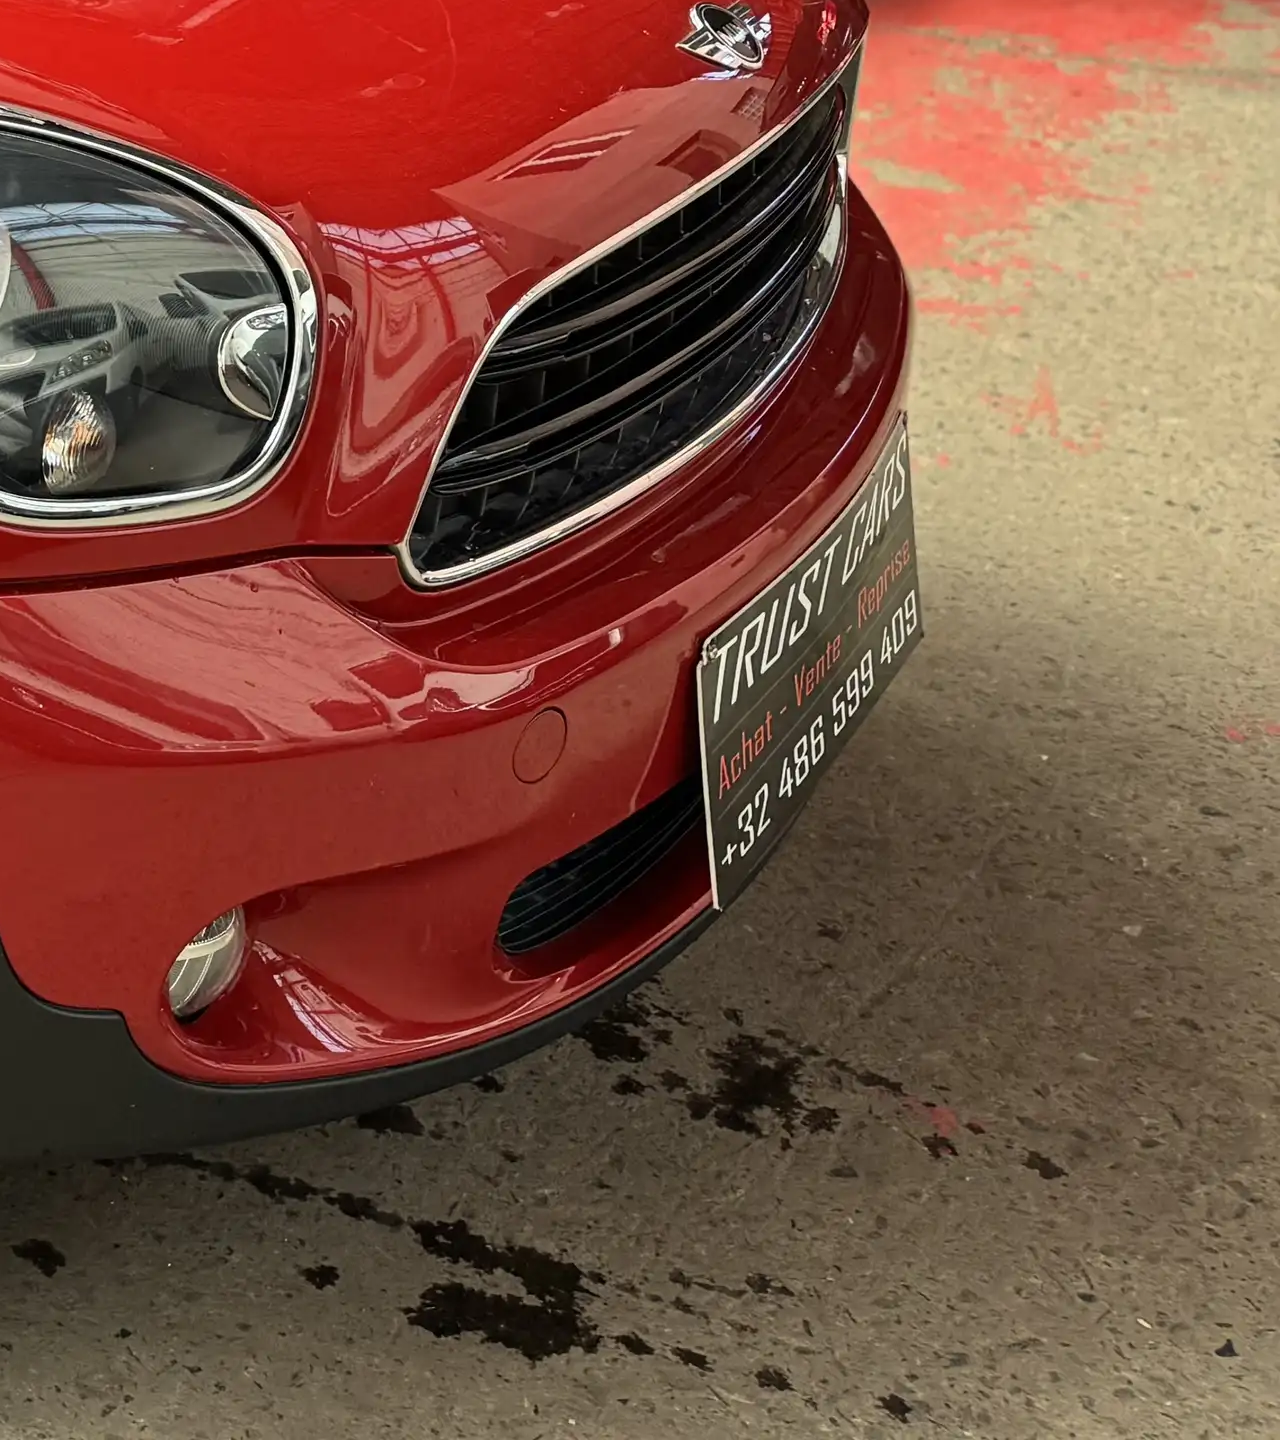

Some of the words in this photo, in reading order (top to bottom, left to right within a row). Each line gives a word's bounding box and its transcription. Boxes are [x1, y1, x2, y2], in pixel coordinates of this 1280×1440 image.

[713, 534, 842, 725] TRUST
[842, 436, 907, 586] CARS
[718, 711, 775, 800] Achat
[793, 633, 841, 708] Vente
[857, 539, 912, 630] Reprise
[721, 784, 772, 866] +32
[778, 715, 826, 800] 486
[832, 649, 875, 736] 599
[879, 589, 918, 671] 409
